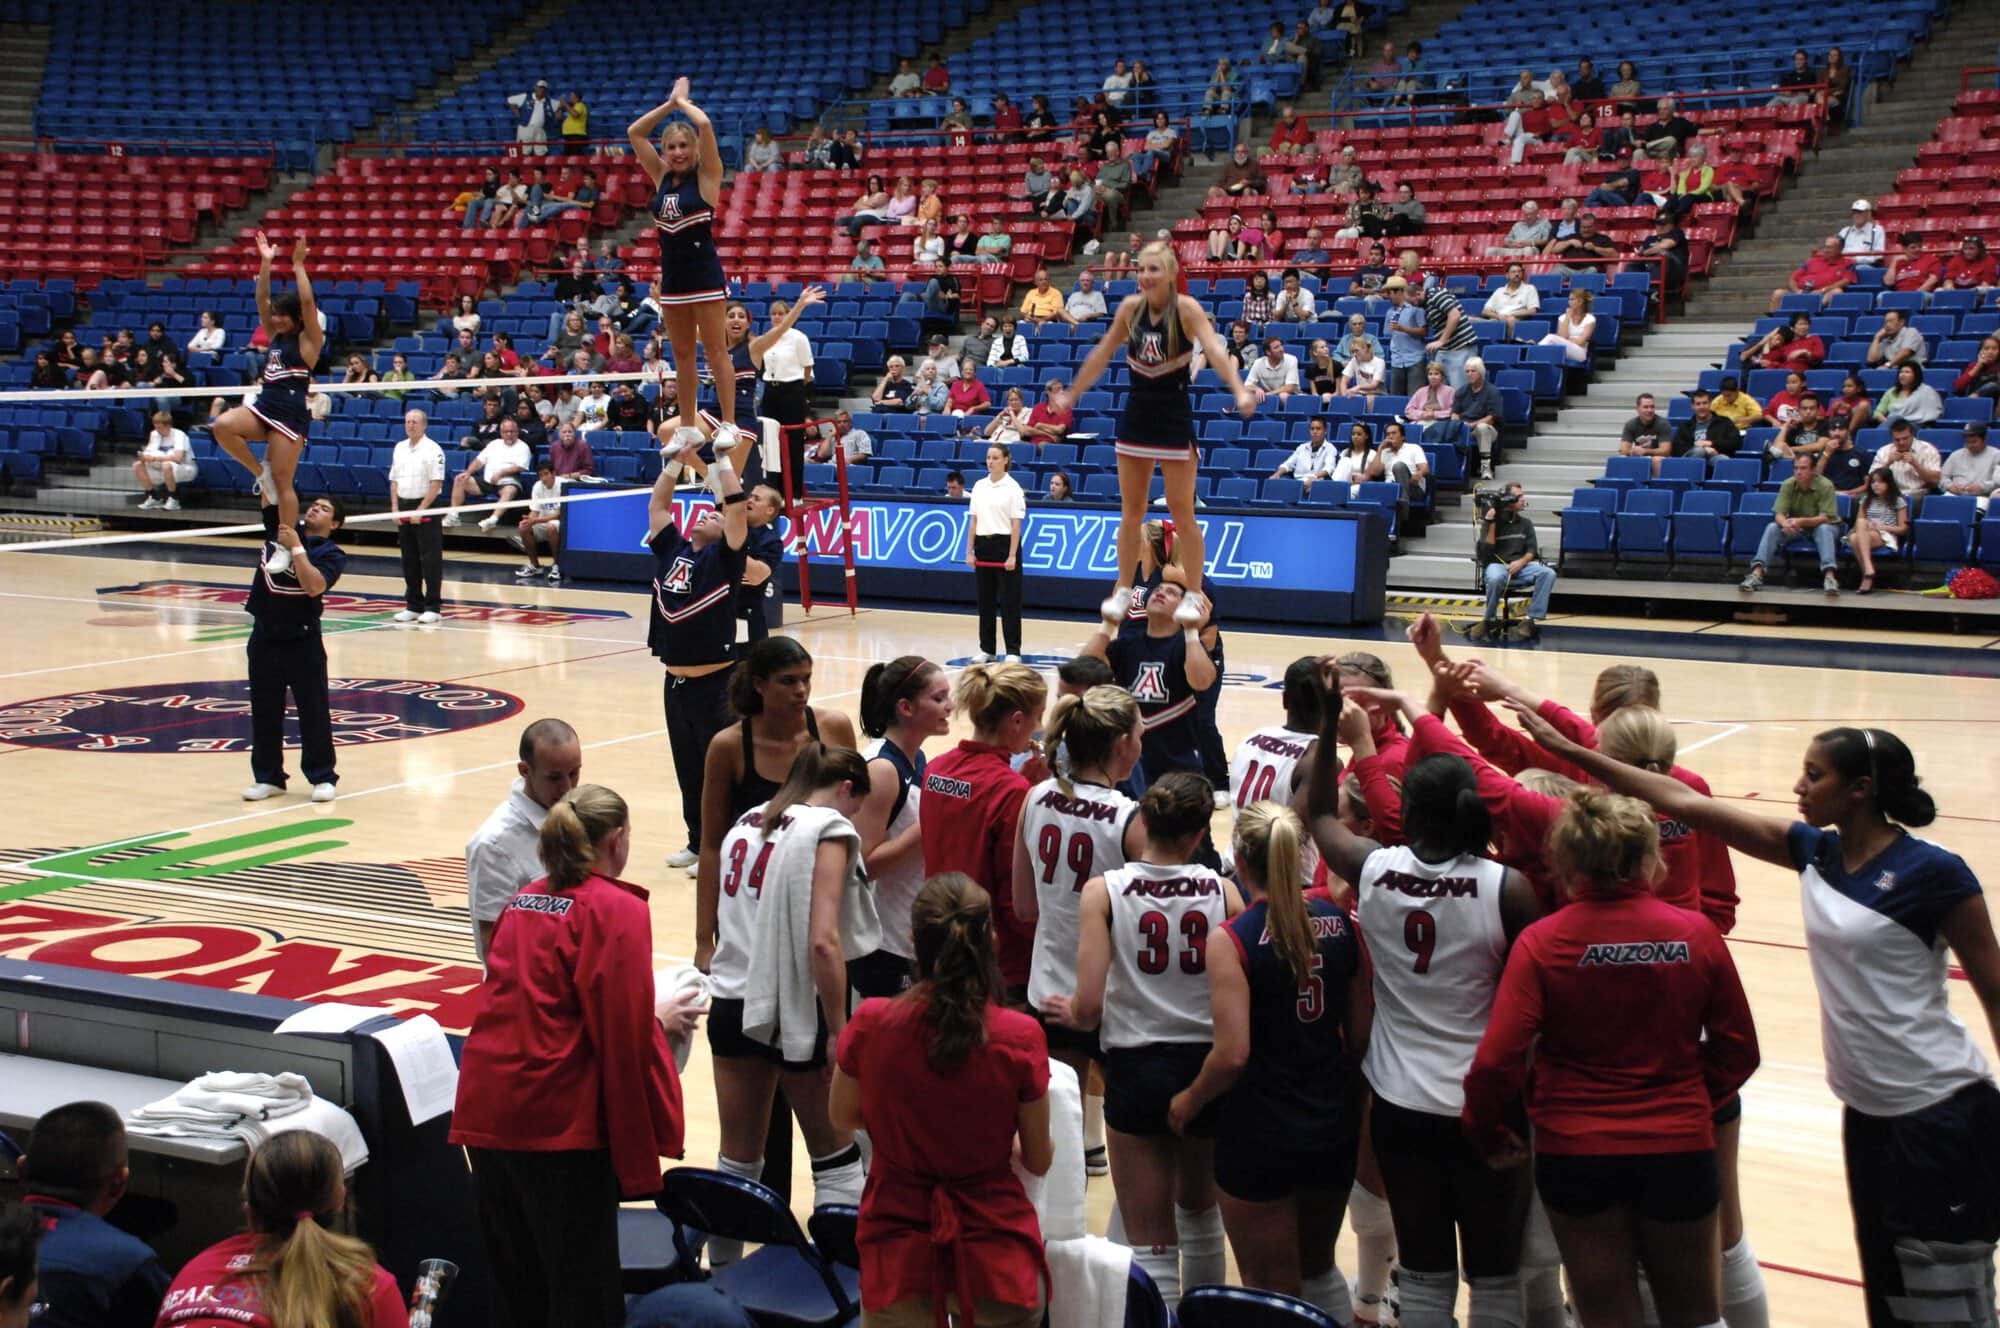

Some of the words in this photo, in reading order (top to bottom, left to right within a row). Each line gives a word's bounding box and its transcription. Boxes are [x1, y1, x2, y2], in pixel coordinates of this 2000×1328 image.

[1597, 104, 1613, 118] 15
[660, 193, 683, 221] A
[662, 556, 695, 593] A
[1128, 662, 1169, 704] A
[926, 774, 971, 800] ARIZONA
[1236, 760, 1276, 809] 10
[724, 838, 776, 900] 34
[1039, 824, 1094, 892] 99
[1122, 877, 1221, 898] ARIZONA
[1372, 869, 1478, 898] ARIZONA
[1137, 910, 1208, 975] 33
[1404, 910, 1436, 974] 9
[1578, 941, 1690, 967] ARIZONA
[1297, 953, 1324, 1023] 5
